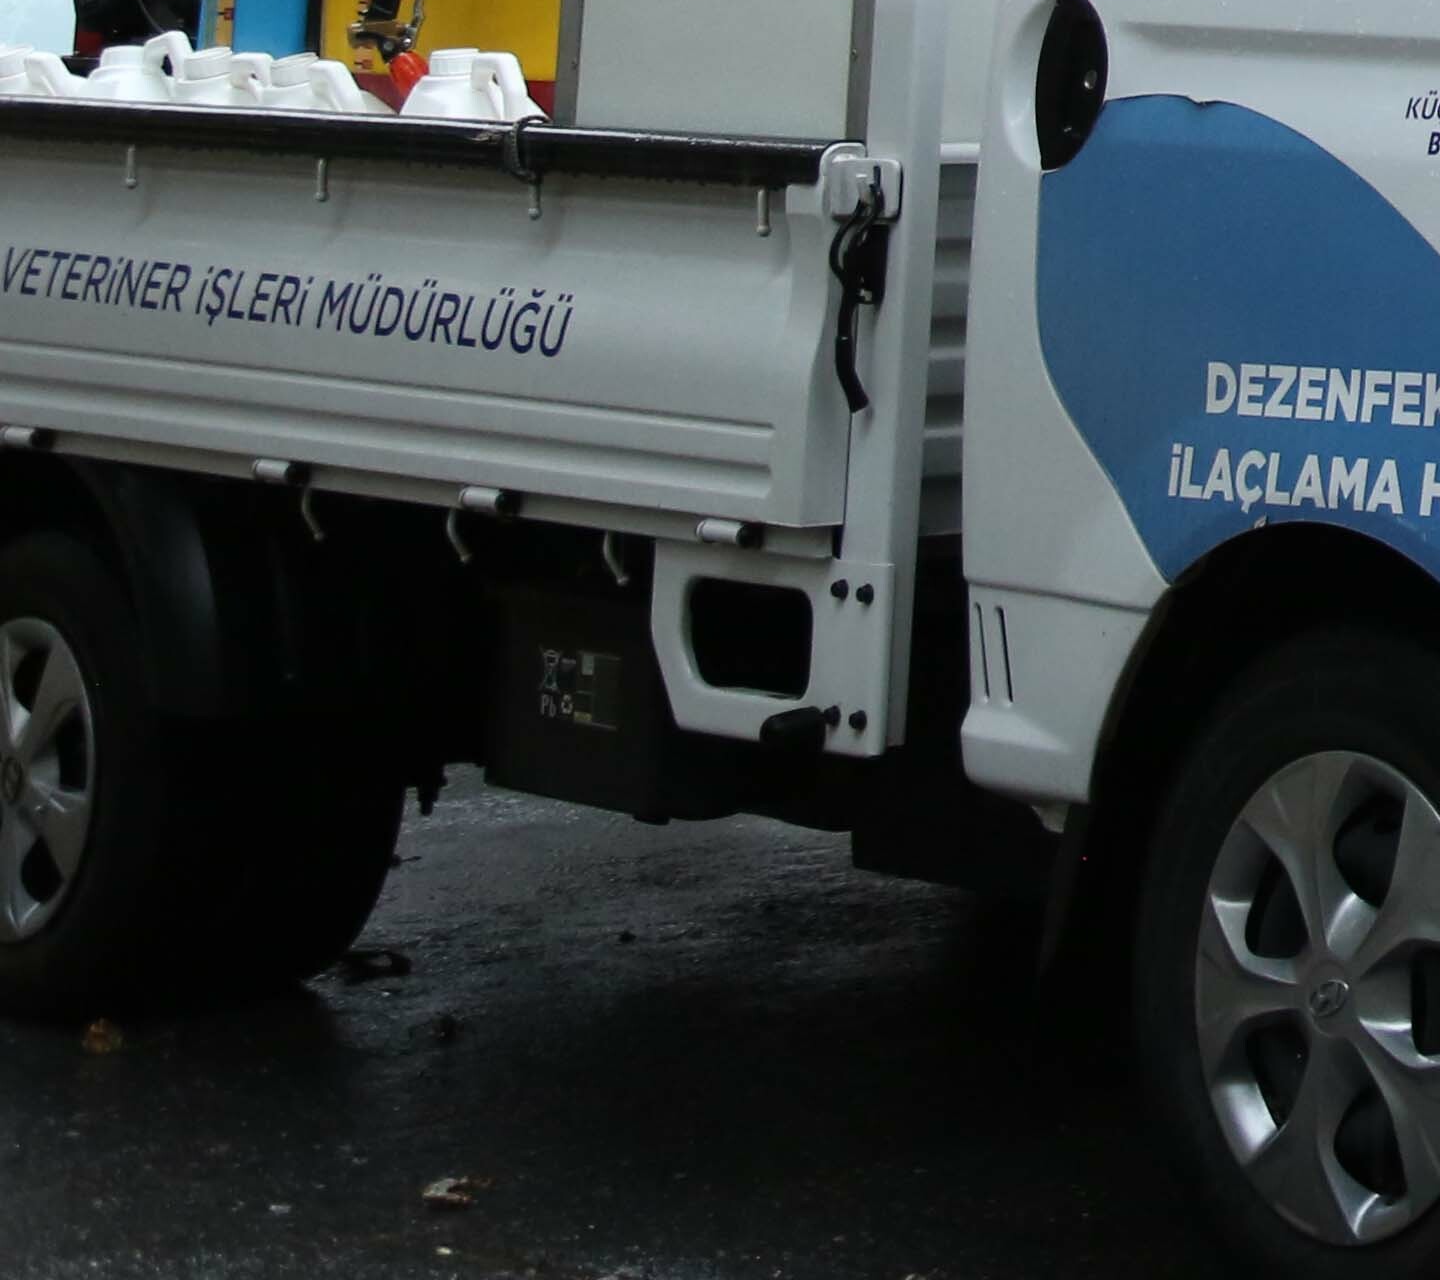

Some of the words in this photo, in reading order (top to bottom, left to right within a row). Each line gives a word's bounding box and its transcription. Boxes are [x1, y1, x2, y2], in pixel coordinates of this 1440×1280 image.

[1, 246, 192, 313] VETERİNER
[195, 265, 314, 328] İŞLERİ
[316, 273, 573, 358] MÜDÜRLÜĞÜ
[1167, 442, 1403, 513] İLAÇLAMA
